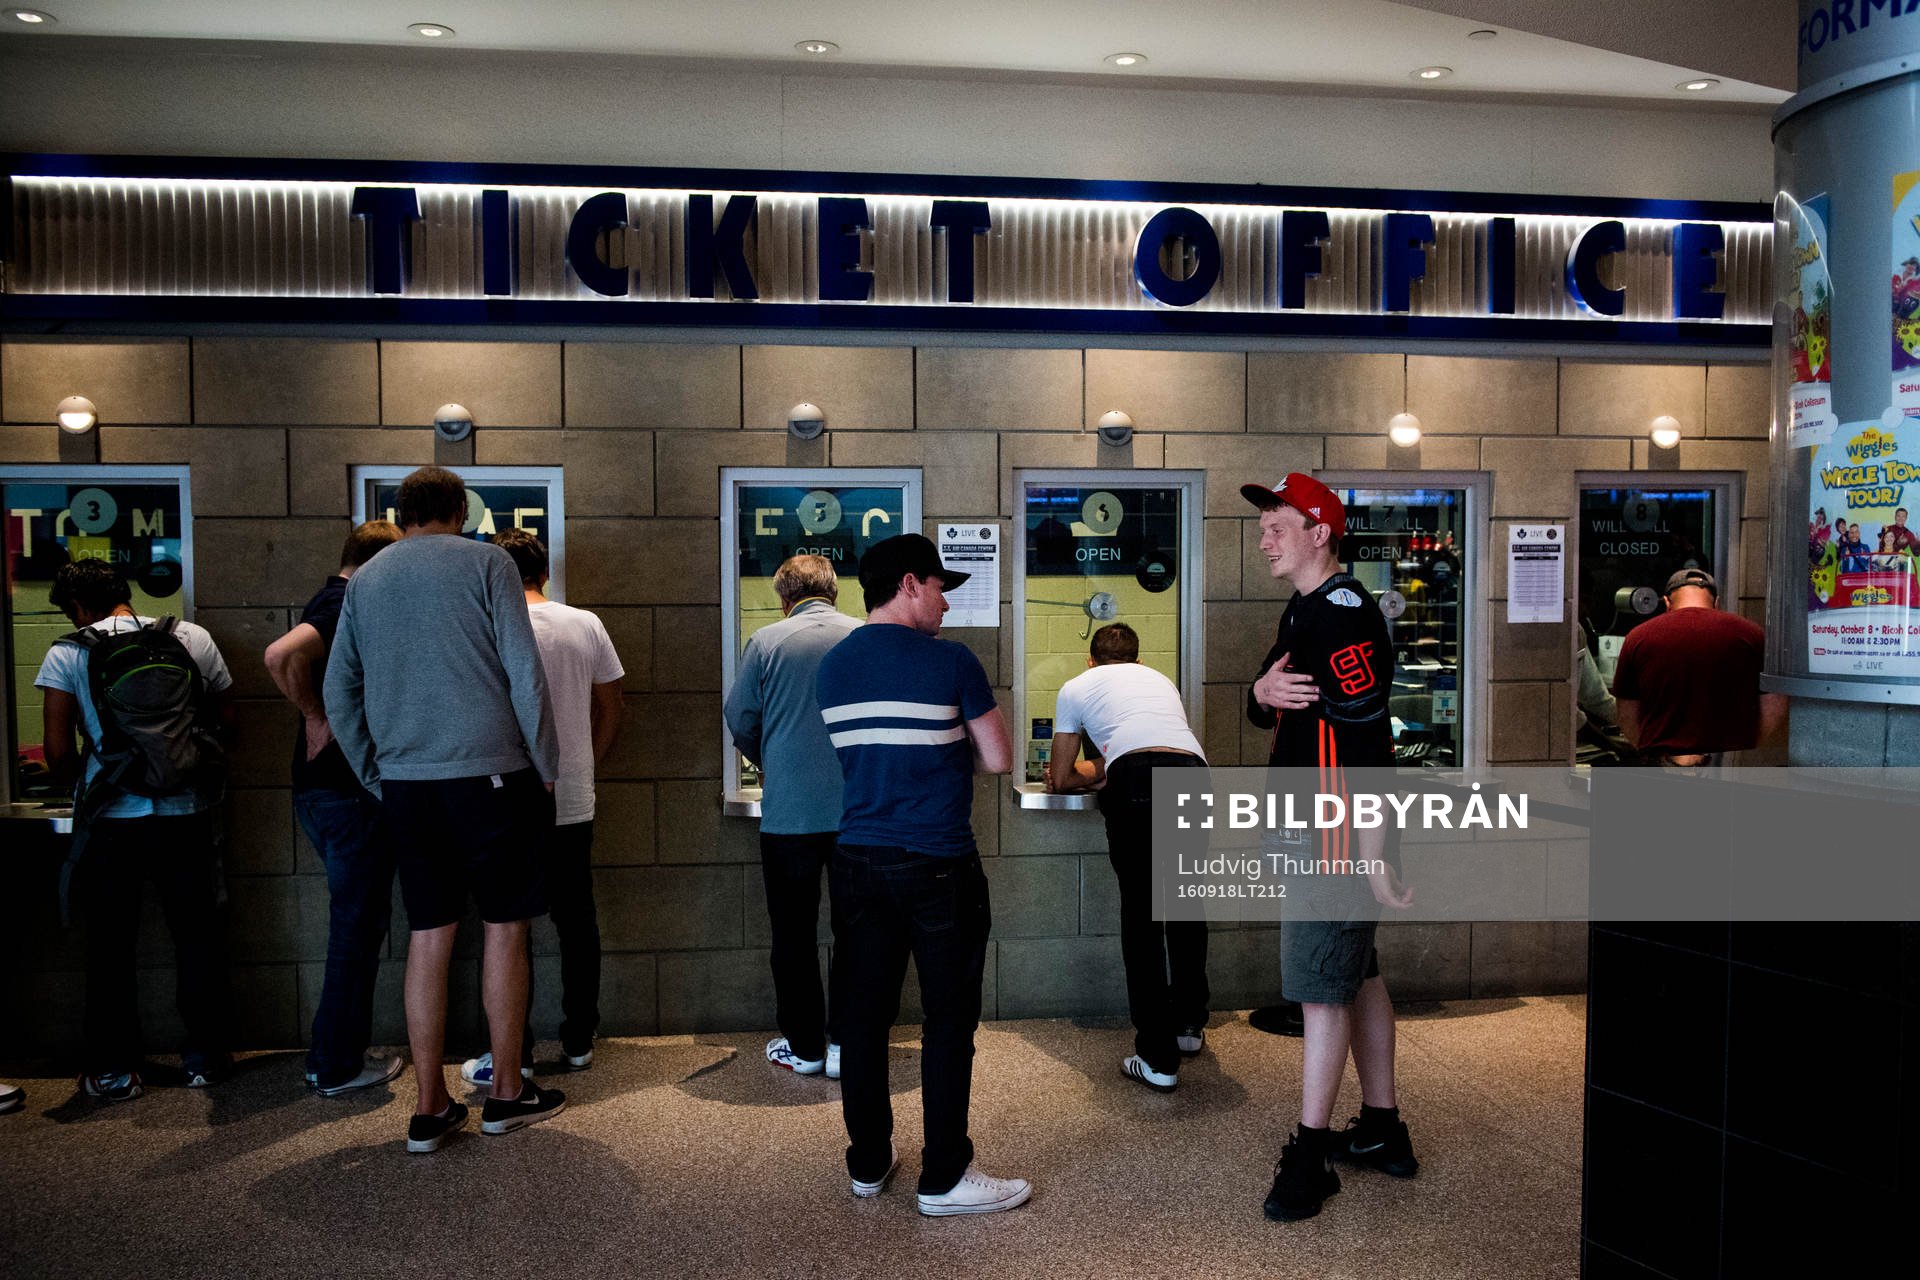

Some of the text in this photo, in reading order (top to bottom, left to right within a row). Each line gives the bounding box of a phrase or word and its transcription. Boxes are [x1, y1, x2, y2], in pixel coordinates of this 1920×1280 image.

[352, 186, 1725, 320] TICKET OFFICE
[1862, 431, 1876, 440] The
[1846, 436, 1898, 459] Wiggles
[1820, 465, 1878, 490] WIGGLE
[1846, 486, 1904, 509] TOUR!
[87, 500, 100, 521] 3
[1637, 504, 1647, 520] 8
[1592, 519, 1628, 533] WILL
[78, 548, 131, 564] OPEN
[795, 547, 843, 561] OPEN
[1075, 547, 1121, 561] OPEN
[1359, 545, 1403, 559] OPEN
[1600, 541, 1660, 556] CLOSED
[1851, 590, 1893, 605] Wiggles
[1812, 624, 1838, 637] Saturday,
[1840, 625, 1865, 635] October
[1868, 625, 1873, 635] 8
[1881, 625, 1904, 635] Ricoh
[1866, 661, 1884, 670] LIVE
